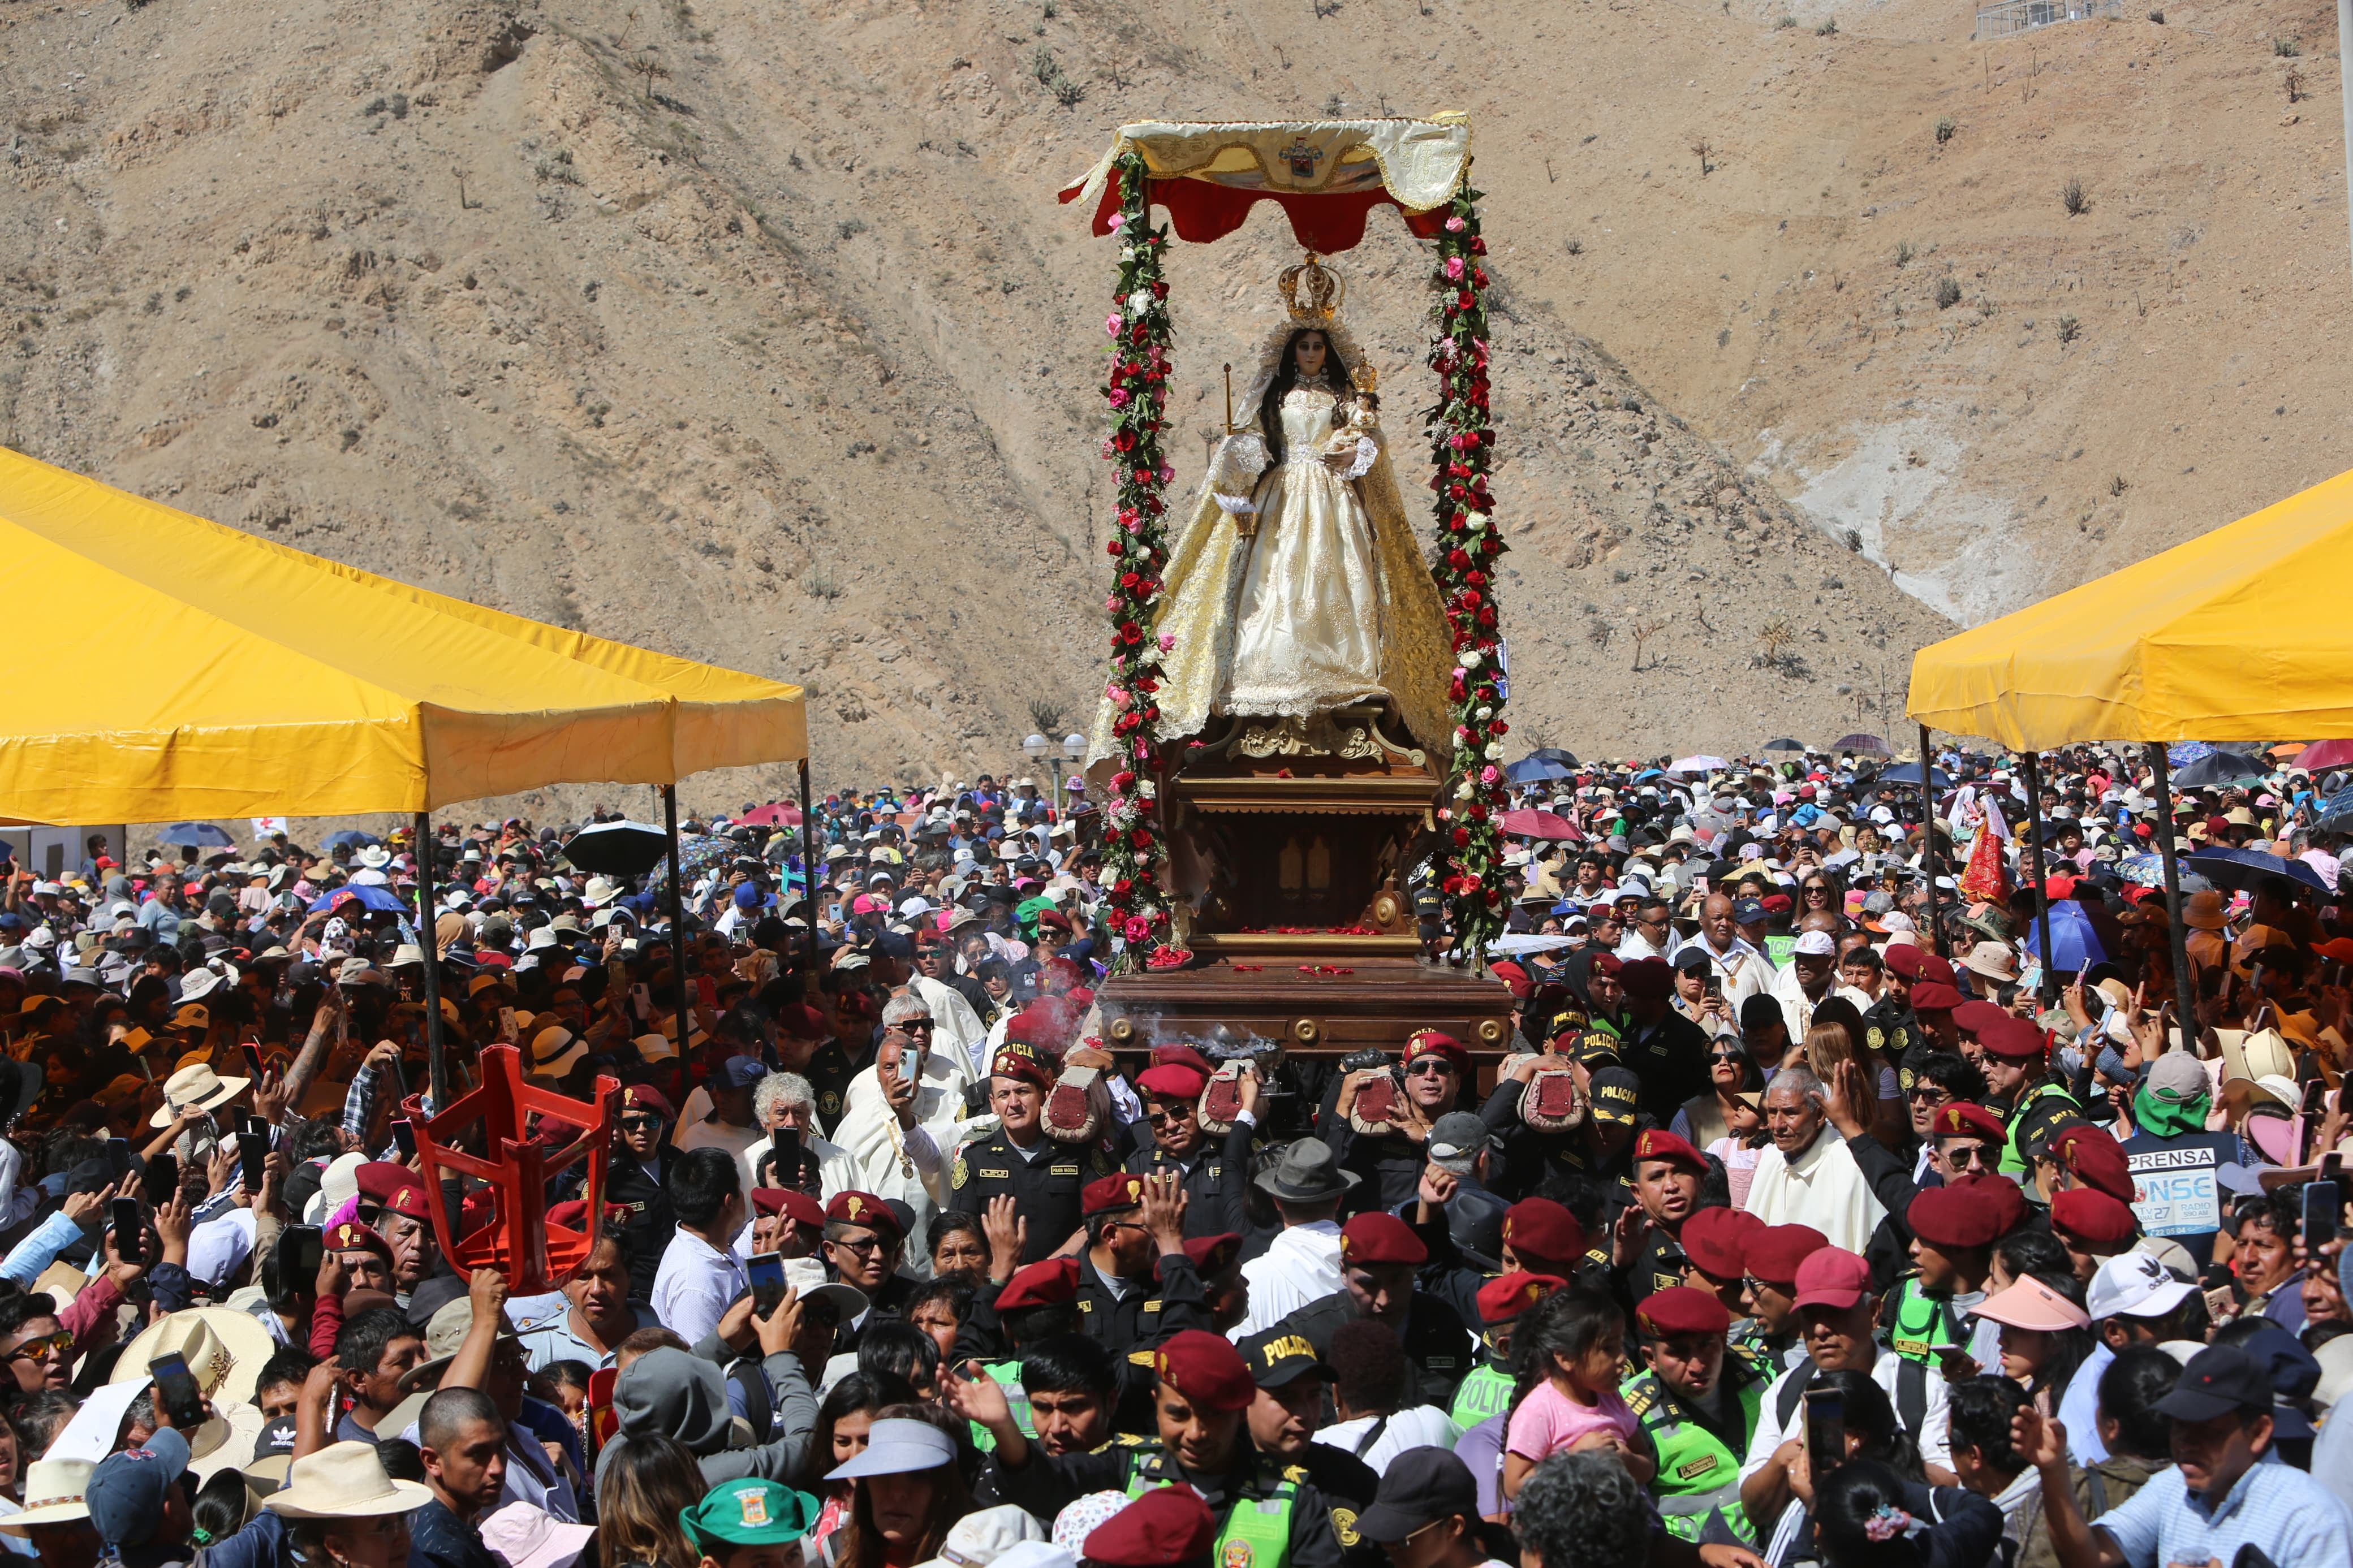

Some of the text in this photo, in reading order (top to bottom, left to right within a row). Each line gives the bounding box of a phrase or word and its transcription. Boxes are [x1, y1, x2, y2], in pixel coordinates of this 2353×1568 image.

[1419, 896, 1439, 905] POLICIA
[1770, 941, 1795, 954] ICIA
[1553, 1012, 1586, 1026] POLICIA
[1584, 1034, 1618, 1053] POLICIA
[1601, 1086, 1637, 1104] POLICIA
[2128, 1150, 2213, 1169] PRENSA
[2154, 1207, 2171, 1220] 27
[2180, 1202, 2211, 1211] RADIO
[2148, 1274, 2171, 1290] adidas
[1262, 1334, 1318, 1367] POLICIA
[1455, 1379, 1515, 1414] POLIC
